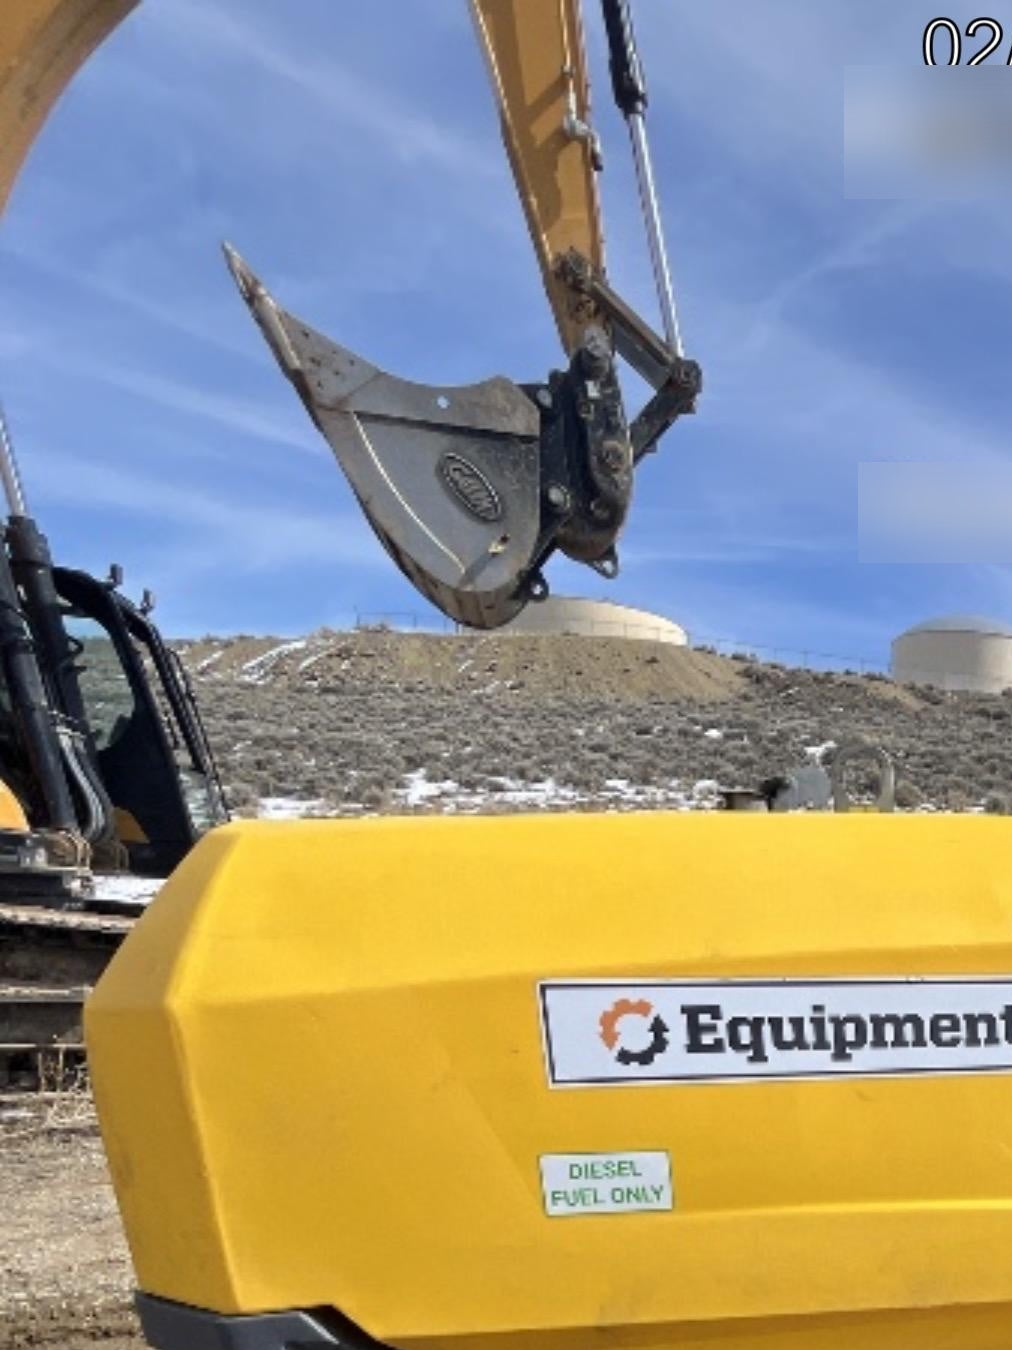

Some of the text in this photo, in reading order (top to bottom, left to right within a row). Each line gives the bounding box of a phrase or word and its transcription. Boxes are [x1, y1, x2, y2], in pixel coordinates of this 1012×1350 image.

[568, 1160, 642, 1180] DIESEL
[550, 1184, 664, 1207] FUEL ONLY
